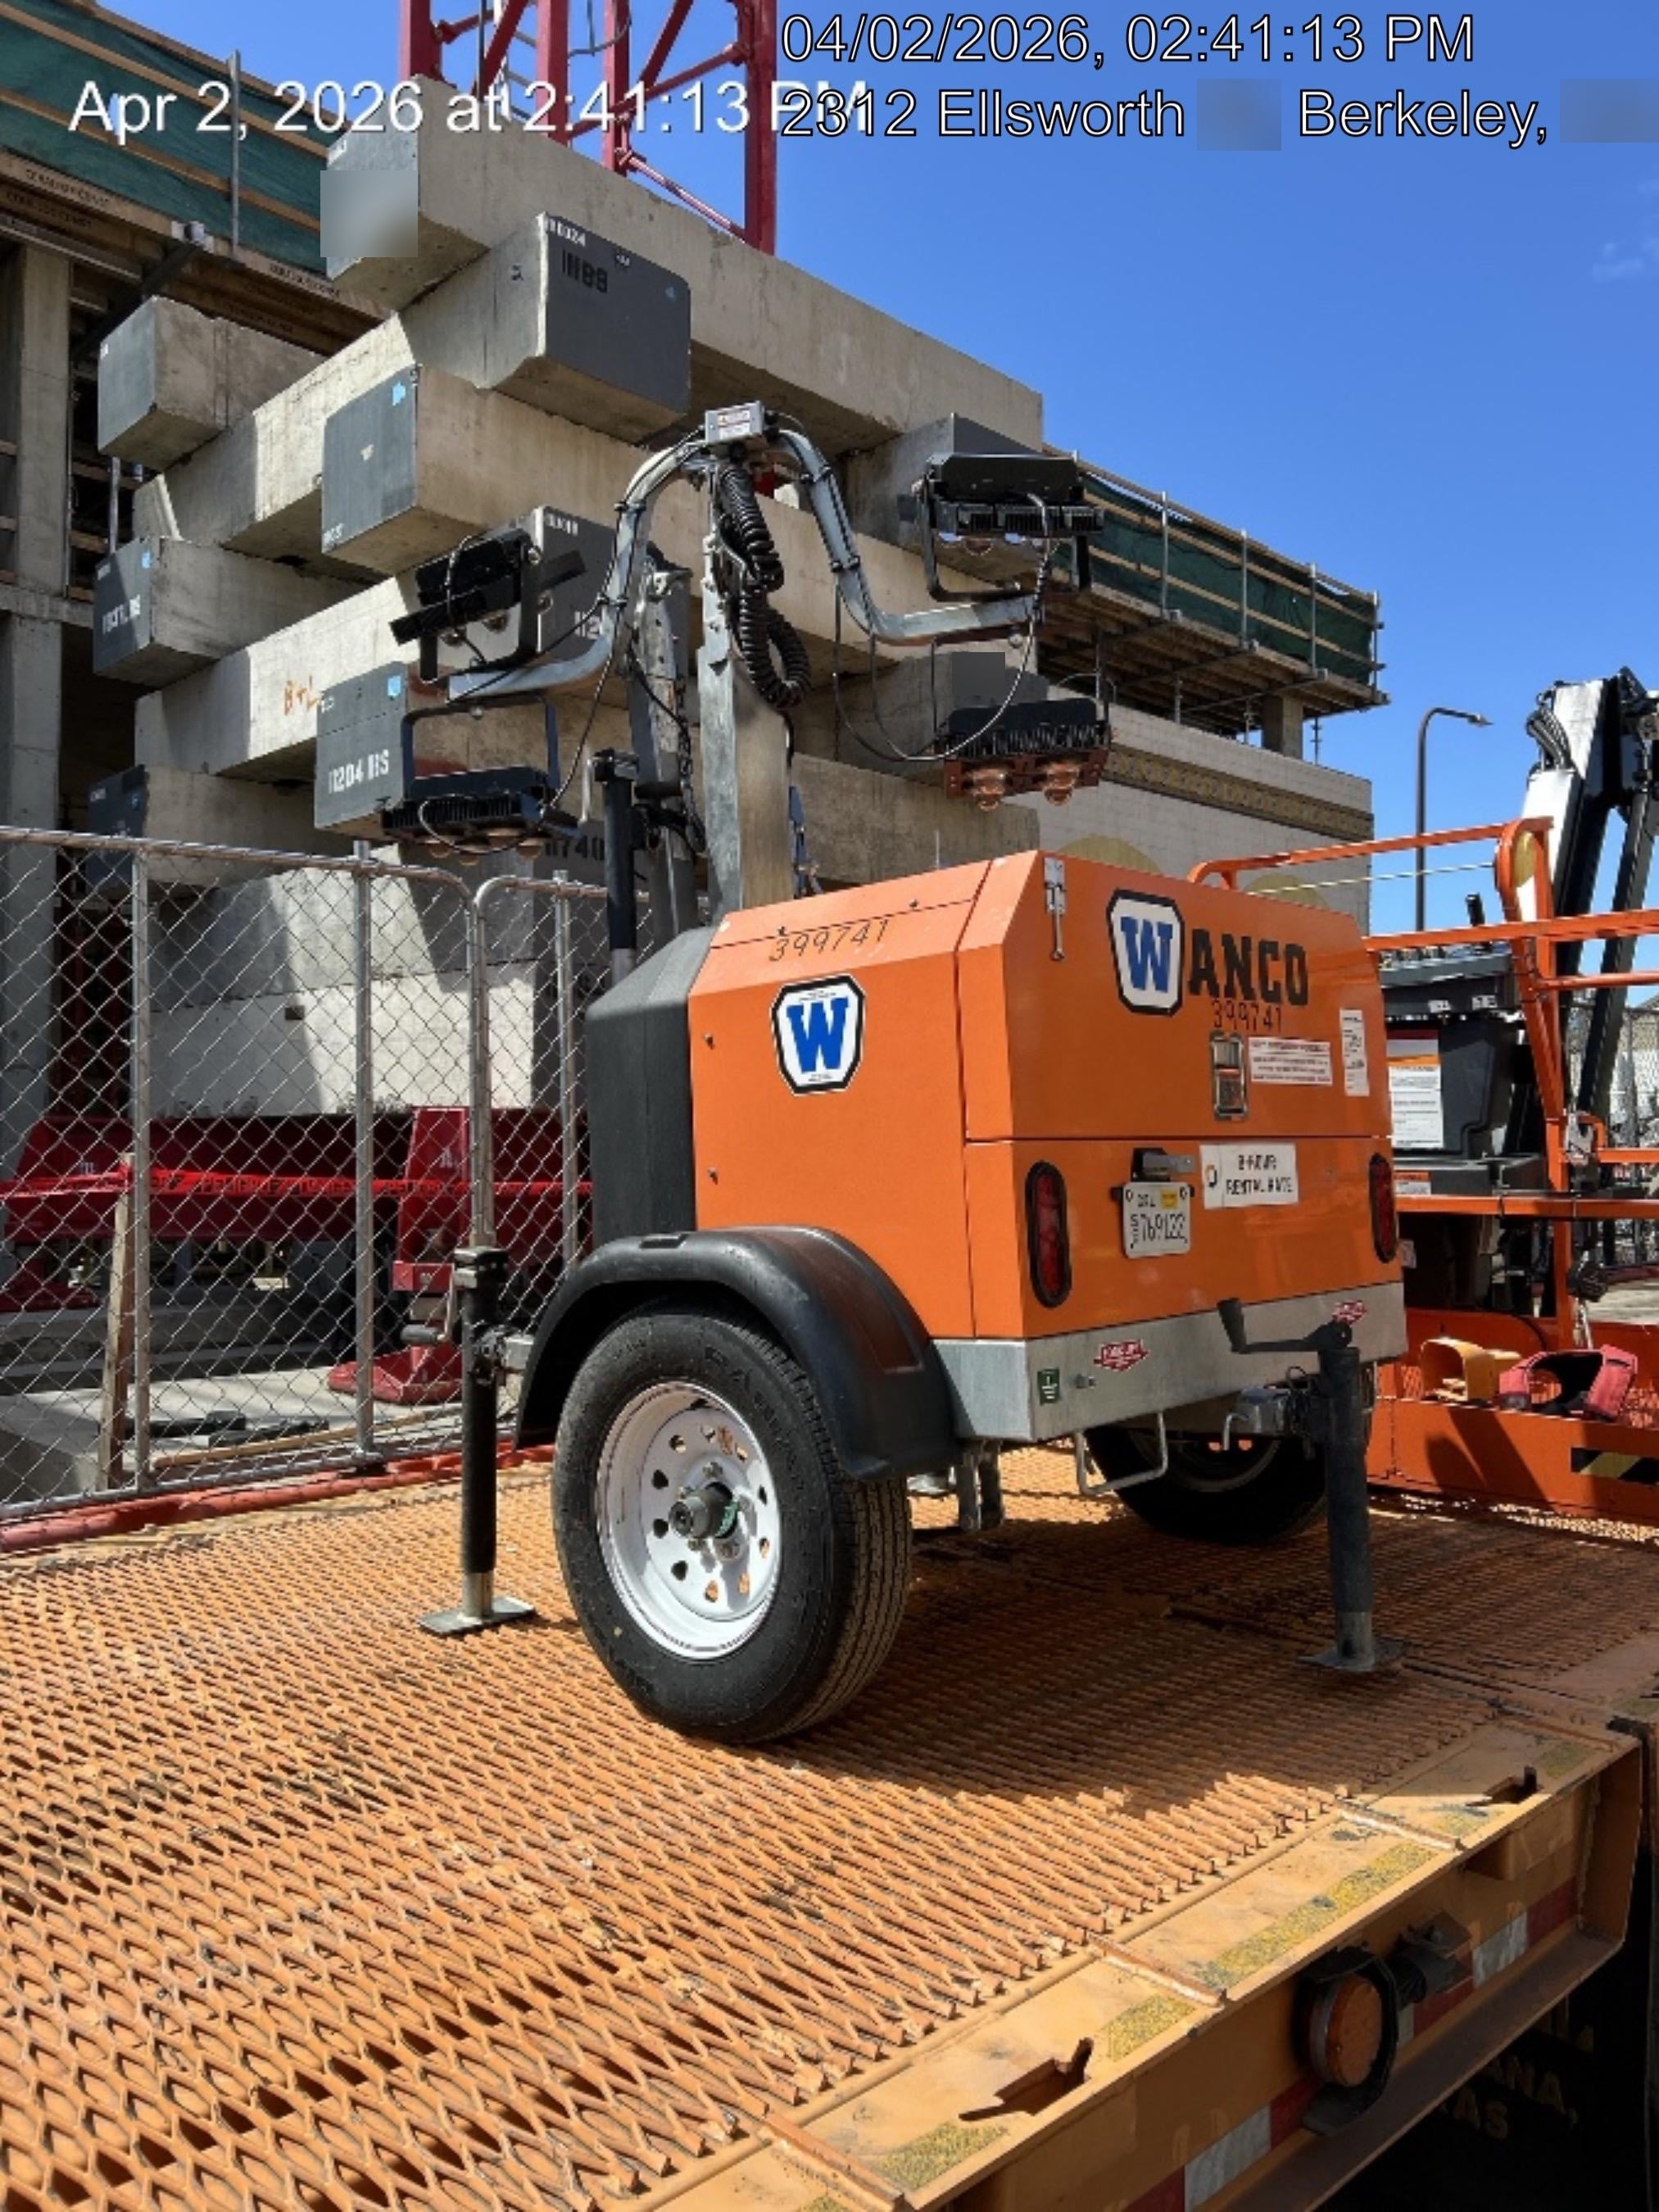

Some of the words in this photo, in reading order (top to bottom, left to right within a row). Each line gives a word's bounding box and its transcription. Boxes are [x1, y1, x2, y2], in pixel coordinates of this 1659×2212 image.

[768, 918, 889, 962] 399741
[1121, 916, 1308, 1006] WANCO
[786, 995, 849, 1075] W
[1211, 999, 1282, 1033] 399741
